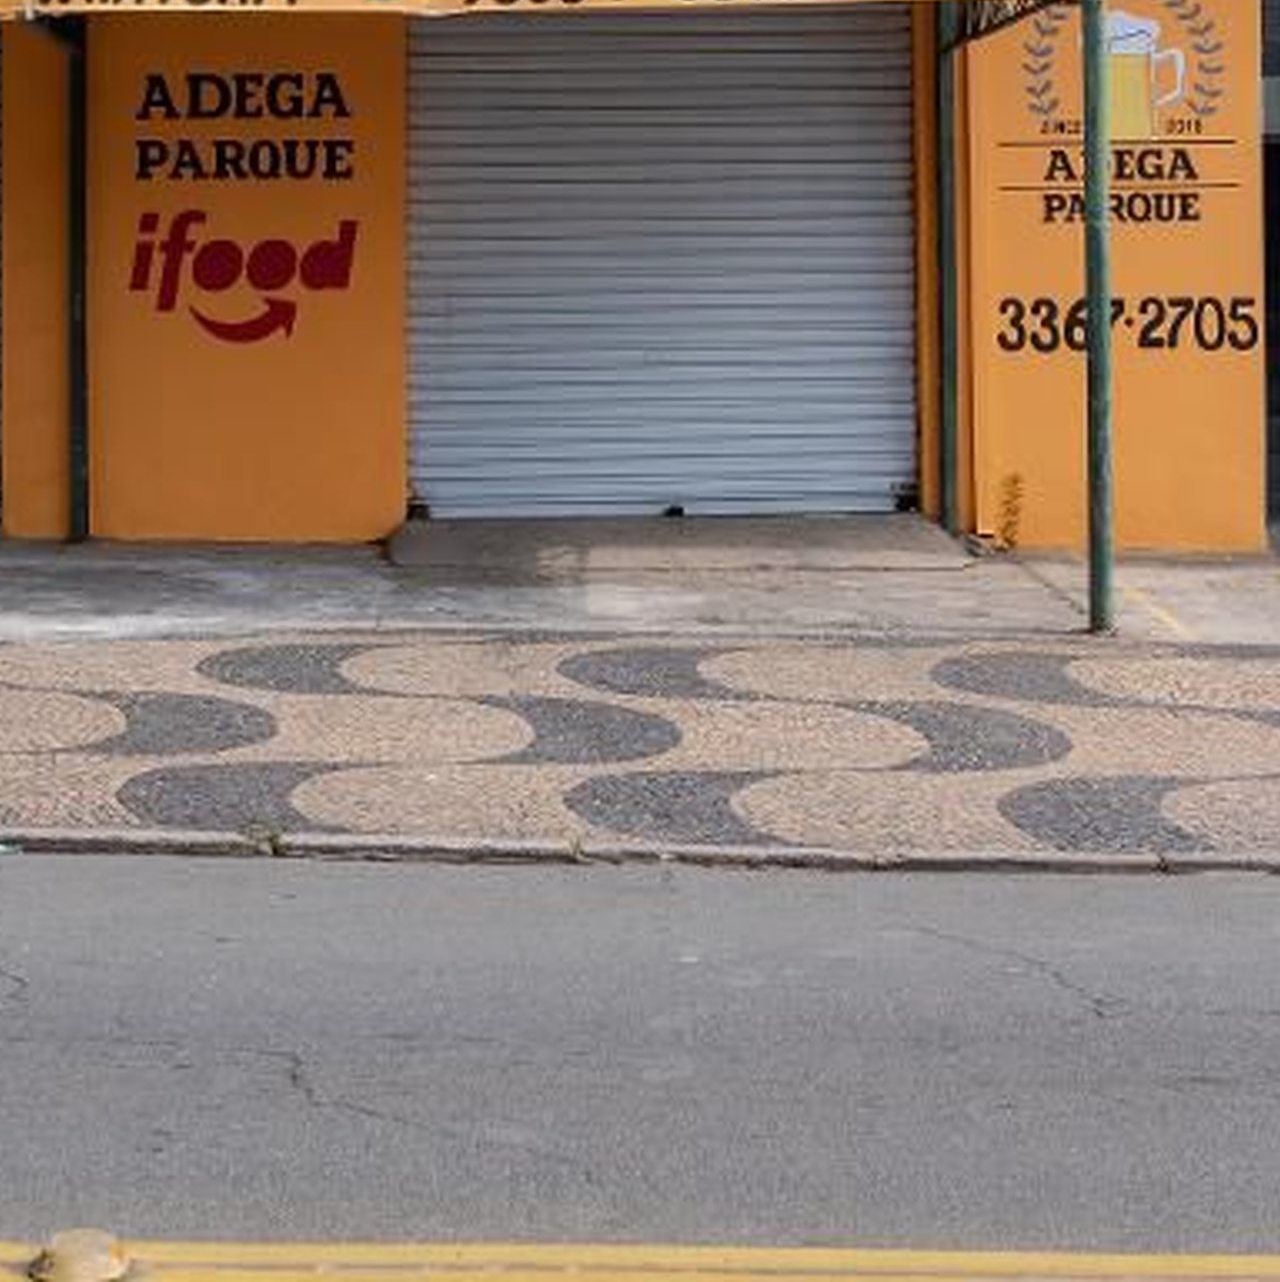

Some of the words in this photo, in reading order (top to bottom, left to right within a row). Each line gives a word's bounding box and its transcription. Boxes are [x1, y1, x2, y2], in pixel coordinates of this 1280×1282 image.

[135, 72, 352, 121] ADEGA
[135, 139, 354, 181] PARQUE
[1043, 148, 1199, 182] AEGA
